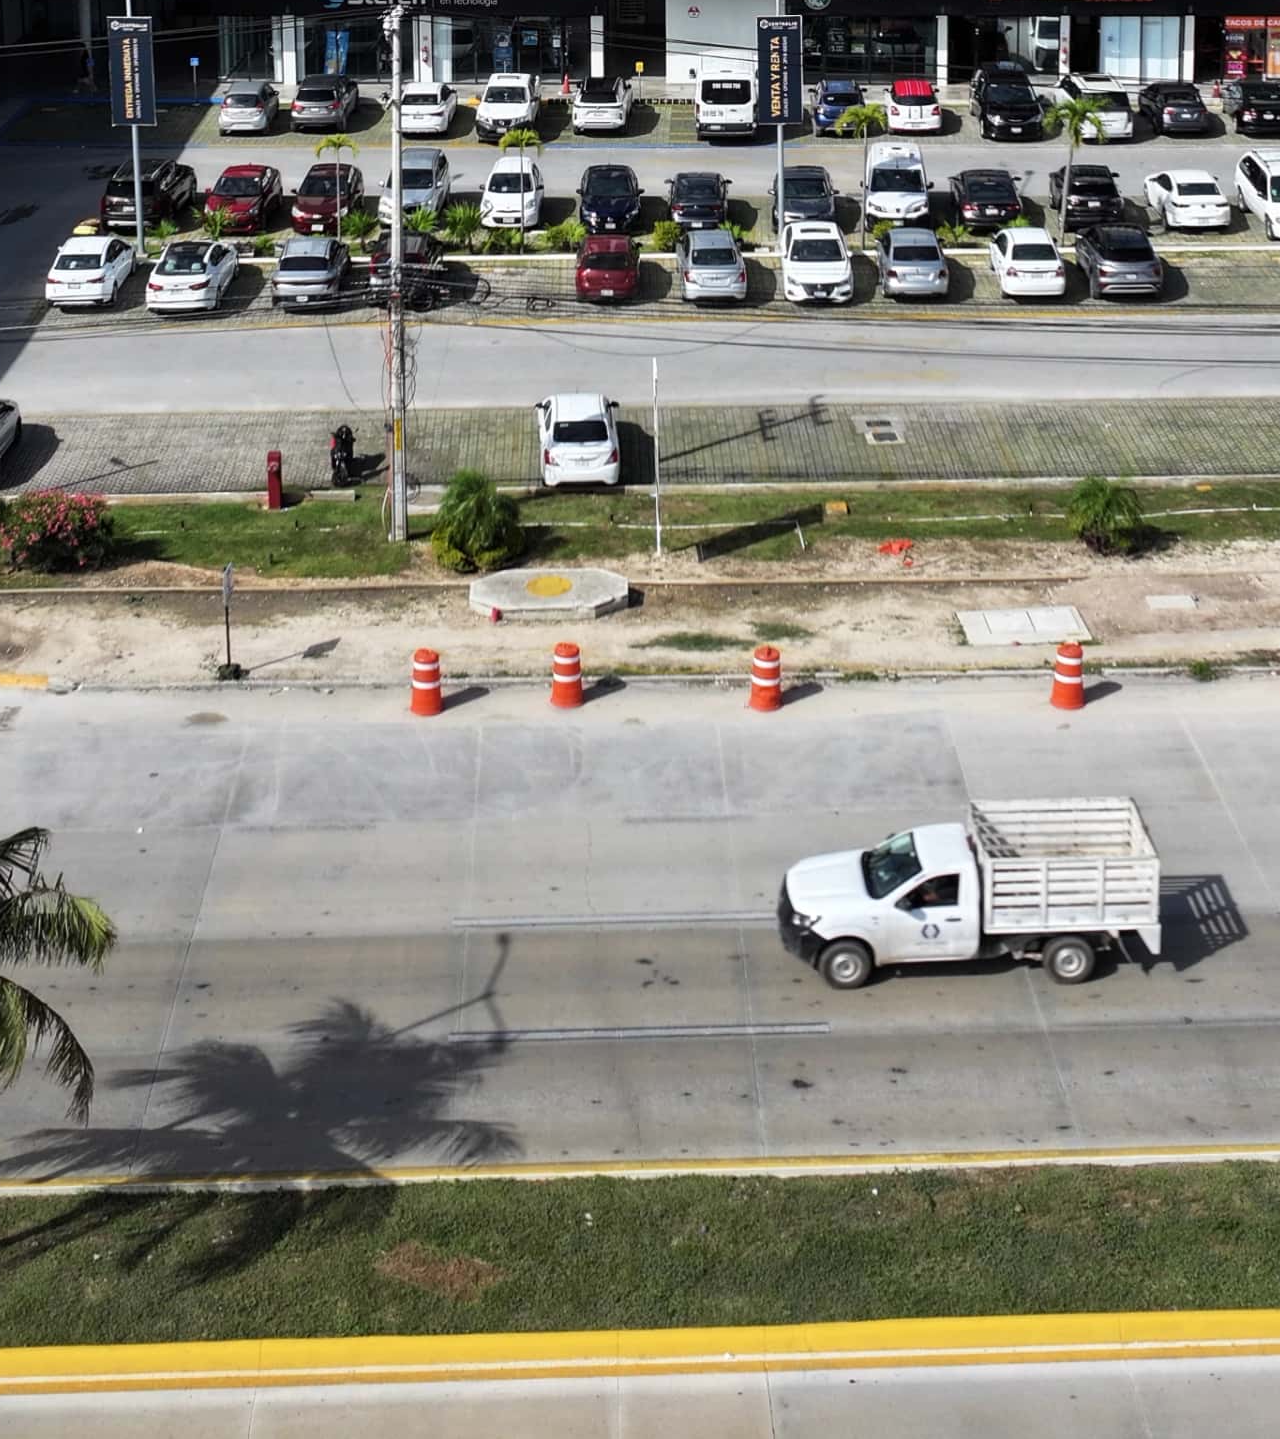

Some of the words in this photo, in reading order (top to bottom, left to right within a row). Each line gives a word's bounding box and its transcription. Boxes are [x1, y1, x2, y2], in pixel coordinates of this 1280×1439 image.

[1224, 19, 1252, 27] TACOS
[1254, 19, 1265, 27] DE
[770, 35, 781, 71] RENTA
[770, 71, 781, 82] Y
[770, 83, 782, 118] VENTA
